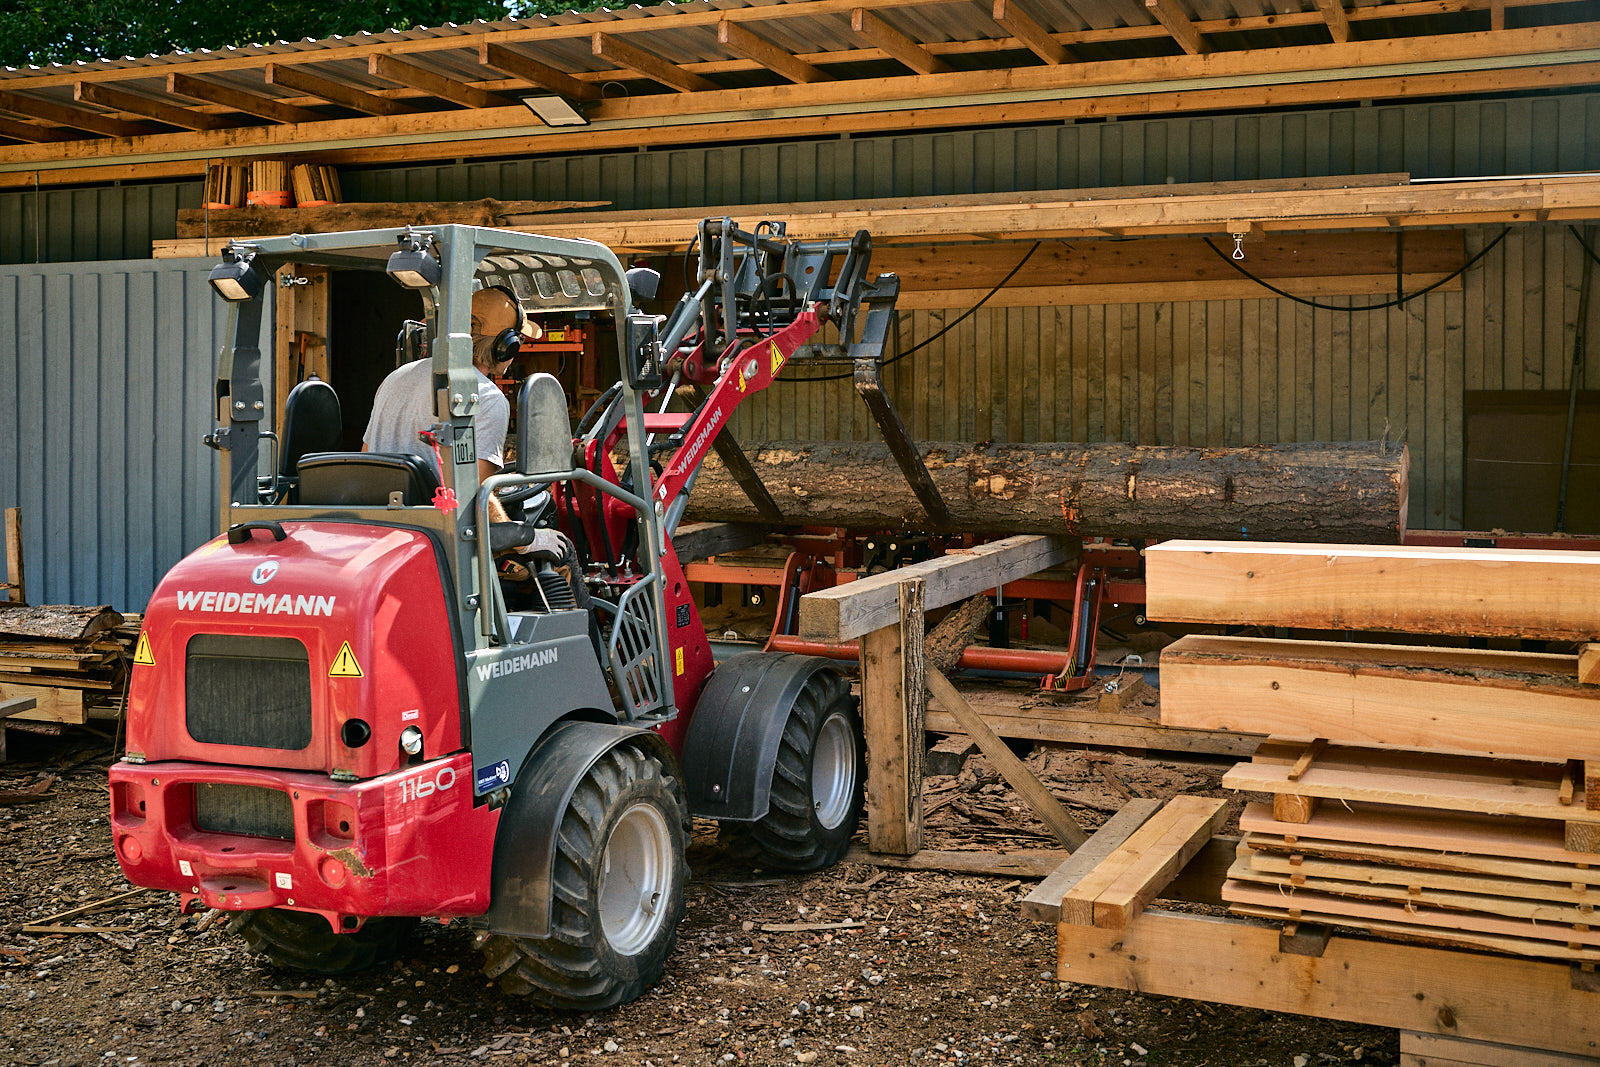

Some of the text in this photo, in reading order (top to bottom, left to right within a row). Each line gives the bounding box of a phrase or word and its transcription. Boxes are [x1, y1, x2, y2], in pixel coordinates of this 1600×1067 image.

[457, 443, 469, 461] 101
[678, 406, 723, 474] WEIDEMANN
[177, 591, 336, 616] WEIDEMANN
[476, 648, 558, 682] WEIDEMANN
[399, 767, 456, 804] 1160
